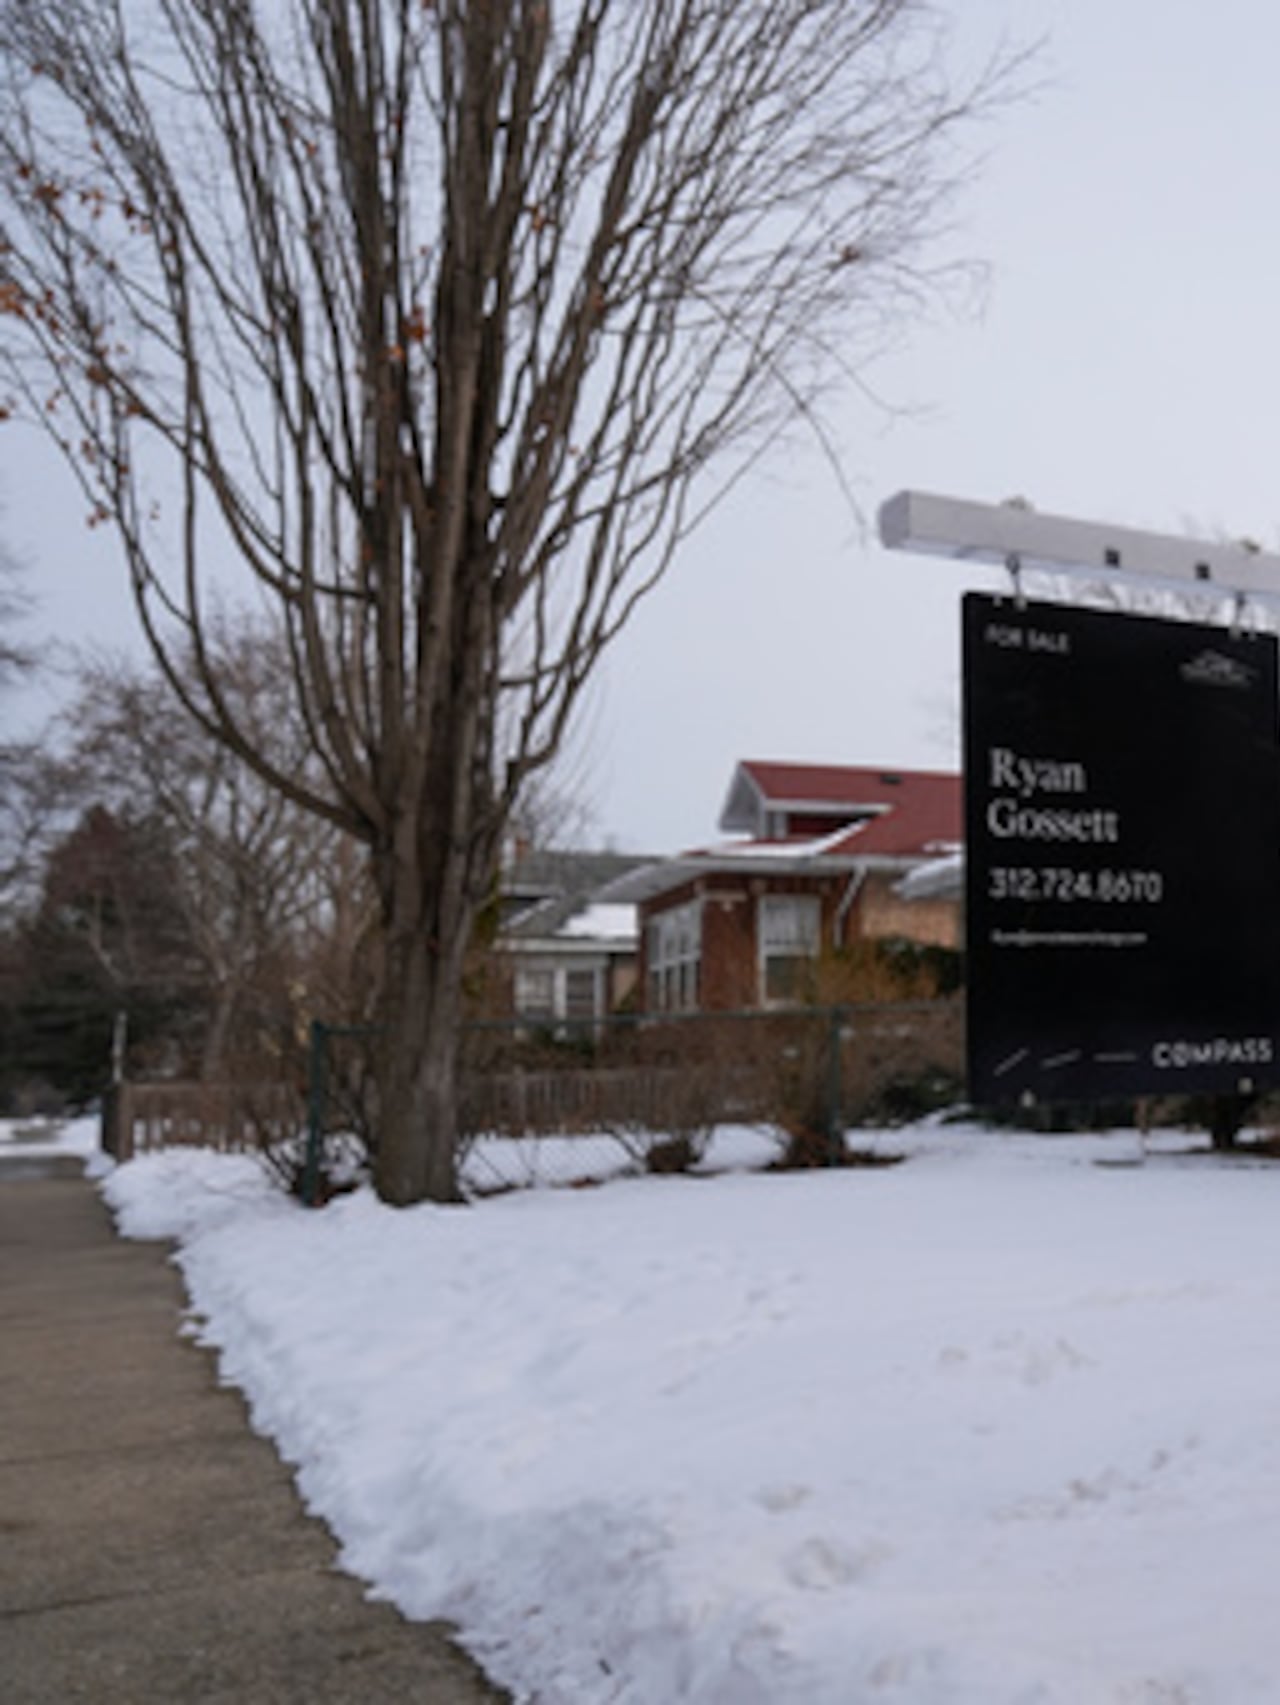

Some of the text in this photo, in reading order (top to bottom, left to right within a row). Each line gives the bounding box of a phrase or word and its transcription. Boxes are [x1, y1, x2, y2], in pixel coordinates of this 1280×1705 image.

[986, 624, 1071, 653] FOR SALE
[989, 748, 1087, 796] Ryan
[986, 799, 1120, 843] Gossett
[1153, 1037, 1273, 1067] COMPASS
